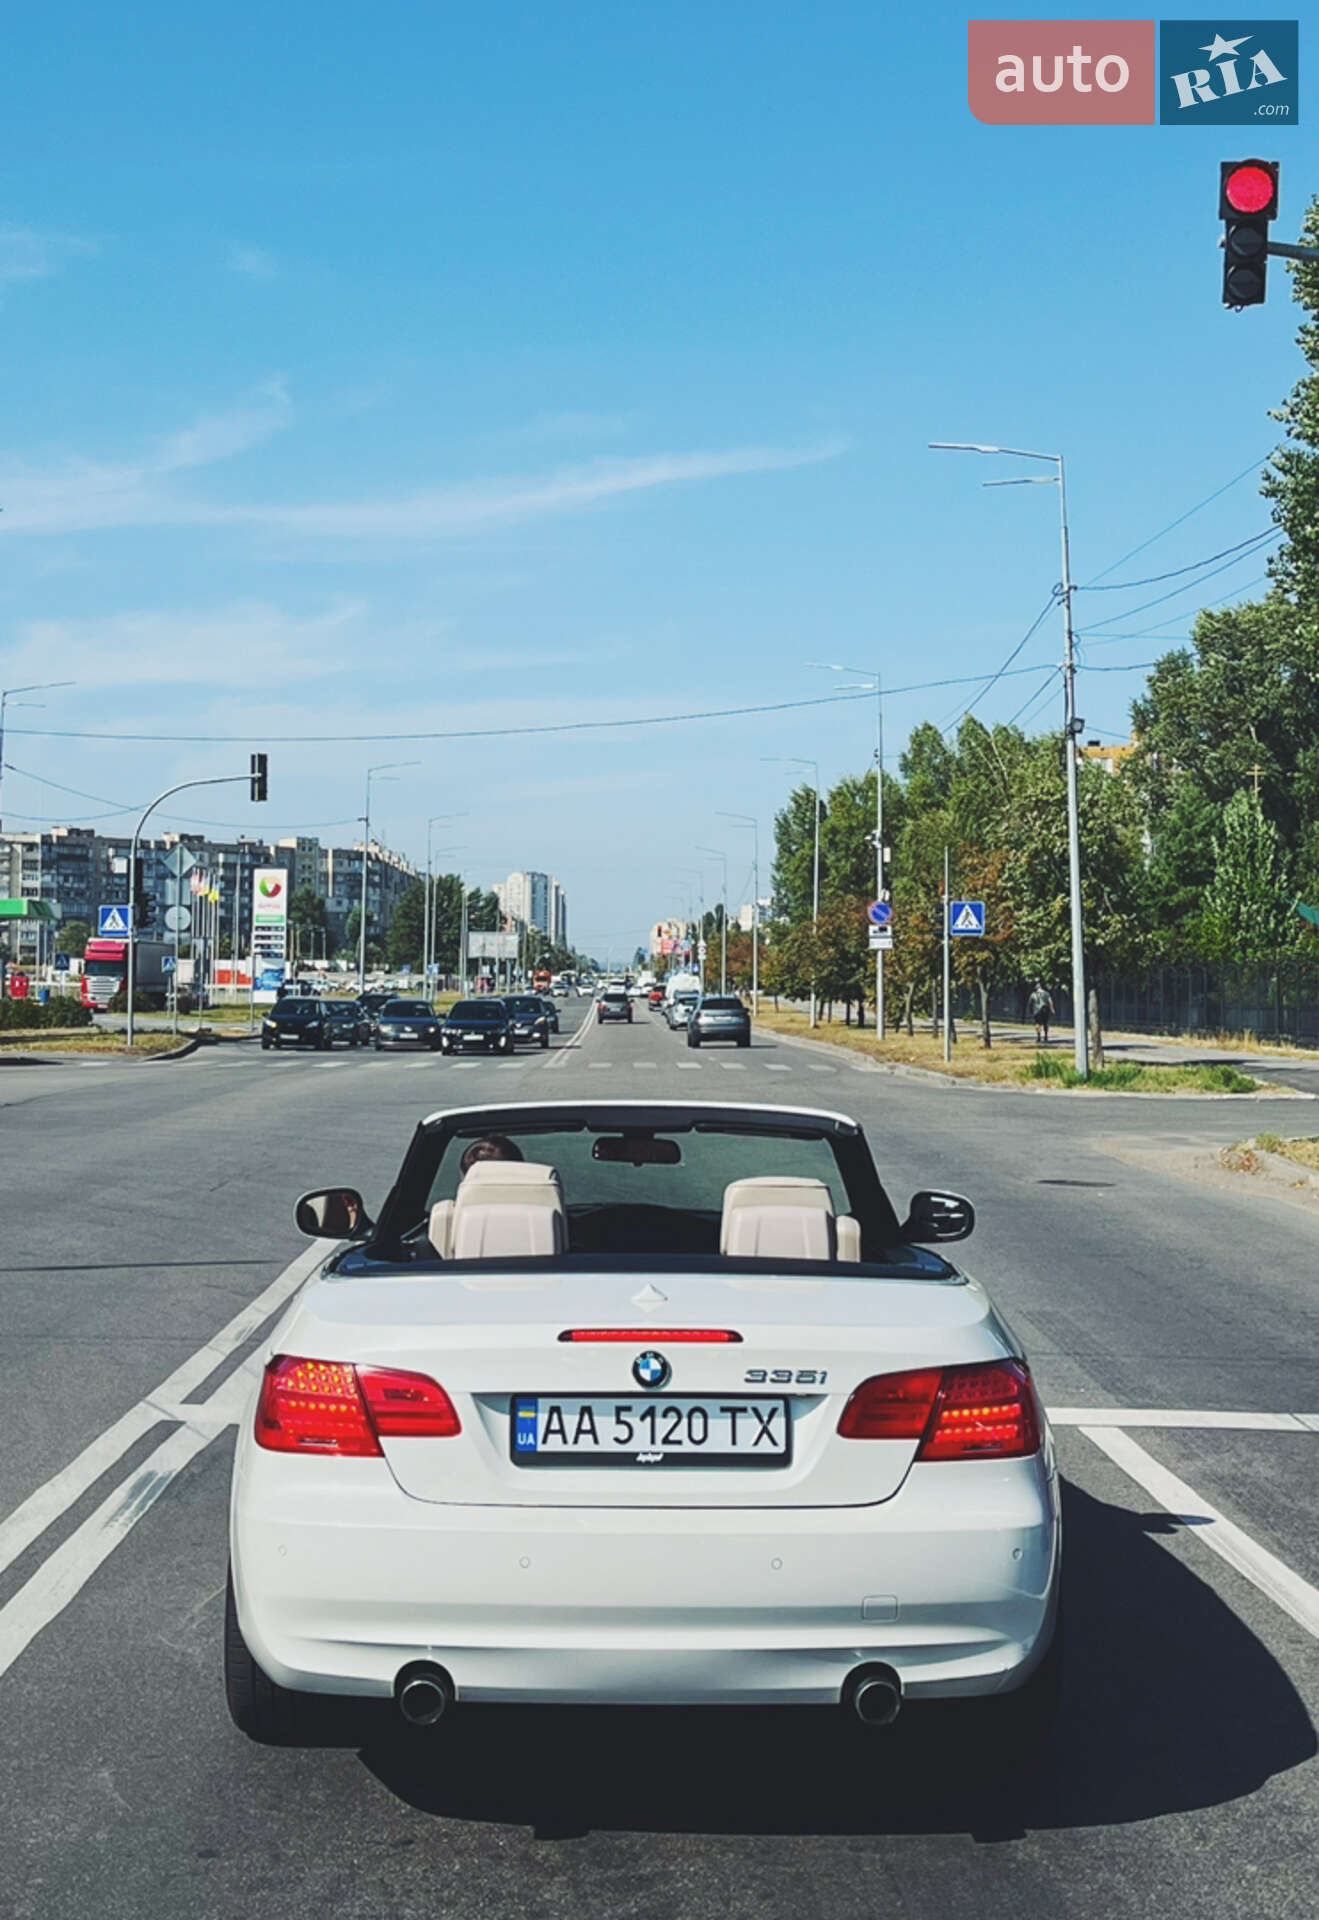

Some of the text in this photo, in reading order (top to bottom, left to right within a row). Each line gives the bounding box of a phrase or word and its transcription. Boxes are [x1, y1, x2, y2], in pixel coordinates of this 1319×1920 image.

[517, 1431, 536, 1446] UA
[541, 1405, 779, 1447] AA 5120 TX
